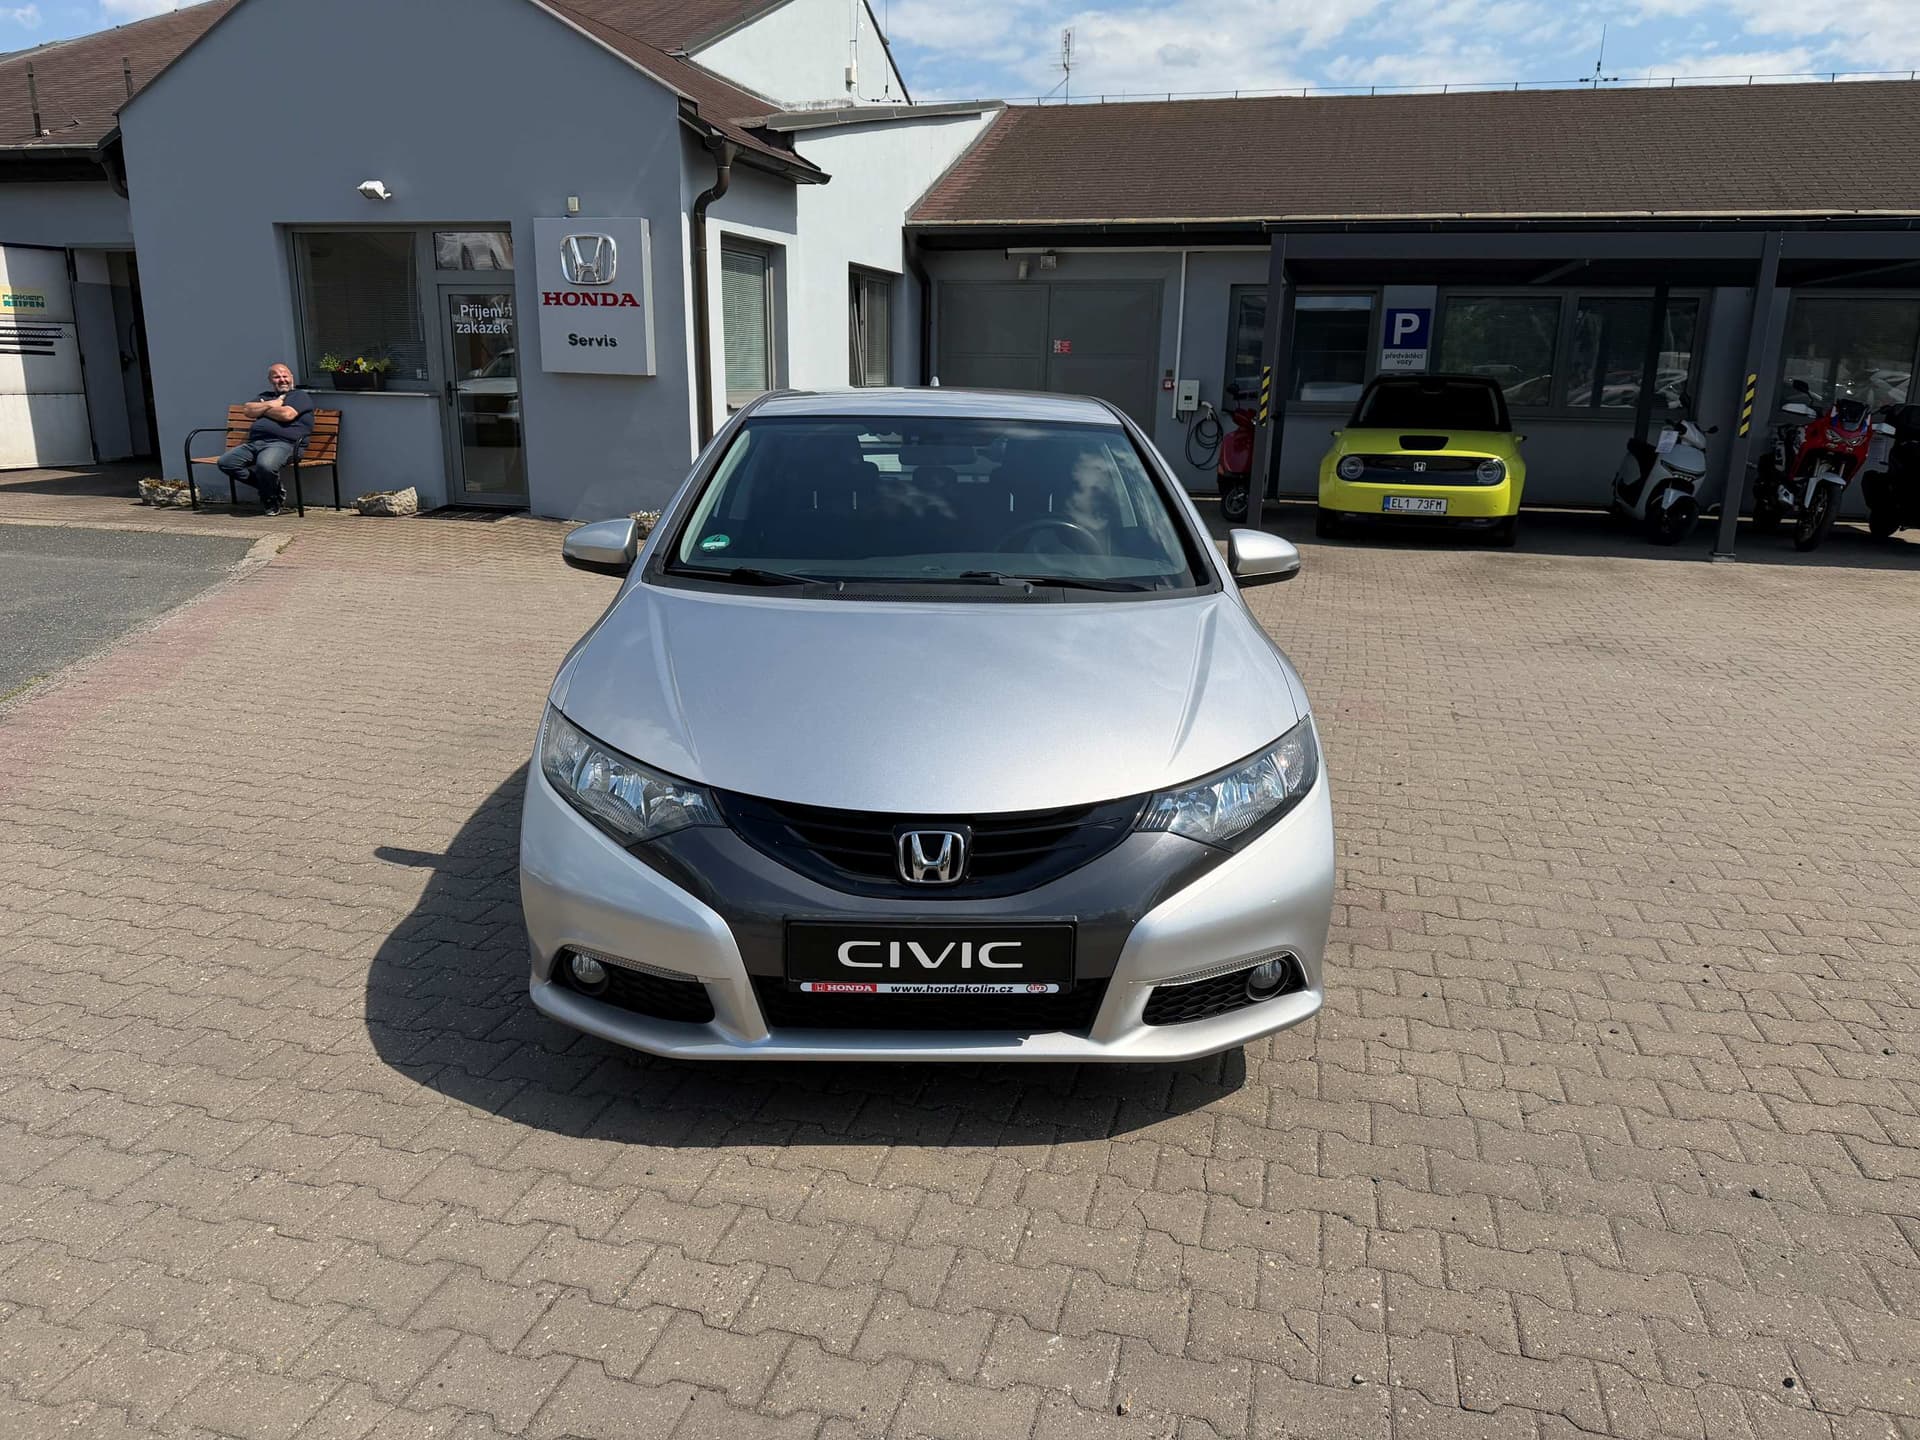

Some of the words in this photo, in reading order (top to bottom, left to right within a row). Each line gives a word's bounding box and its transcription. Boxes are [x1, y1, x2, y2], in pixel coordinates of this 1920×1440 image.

[542, 291, 640, 307] HONDA
[456, 320, 509, 334] zakázek
[1393, 313, 1420, 345] P
[568, 333, 618, 347] Servis
[1391, 498, 1410, 508] EL1
[1417, 499, 1442, 510] 73FM
[837, 941, 1023, 968] CIVIC
[827, 984, 873, 992] HONDA
[890, 984, 1014, 993] www.hondakolin.cz
